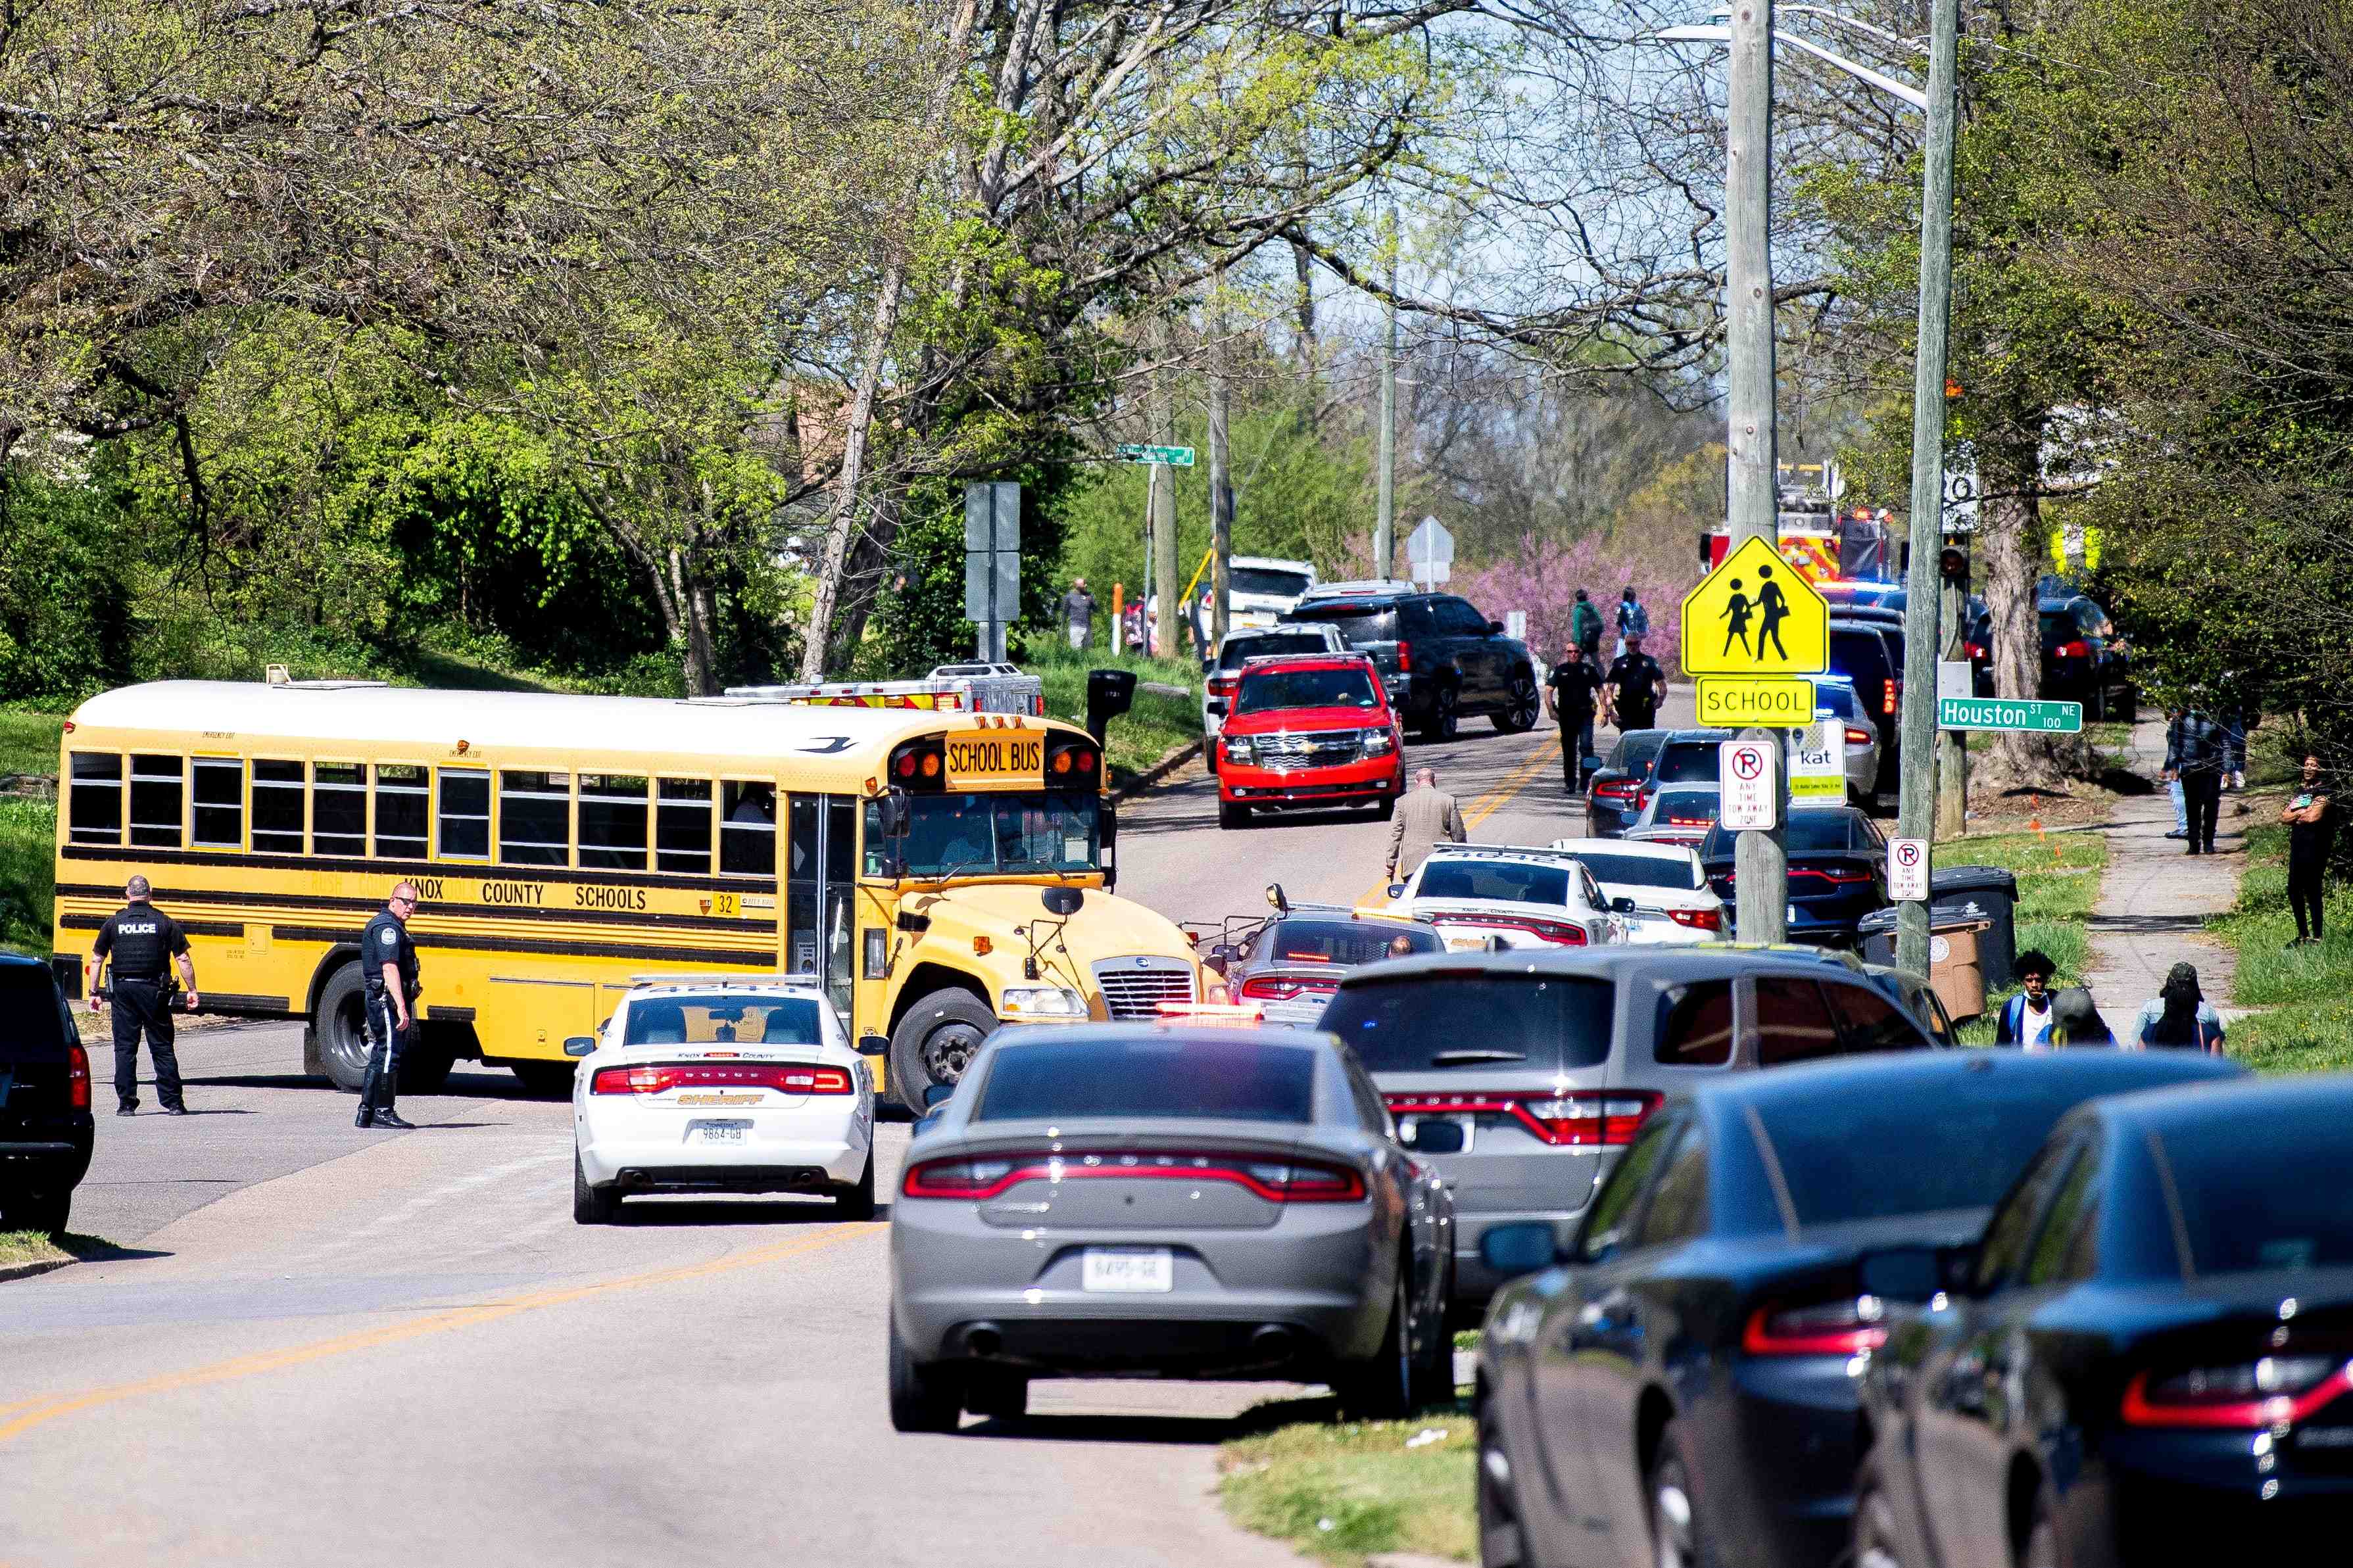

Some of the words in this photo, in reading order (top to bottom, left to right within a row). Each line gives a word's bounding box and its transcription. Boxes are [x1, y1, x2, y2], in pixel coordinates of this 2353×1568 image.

[1708, 692, 1807, 711] SCHOOL
[1944, 701, 2026, 726] Houston
[2030, 703, 2043, 715] ST
[2062, 705, 2075, 716] NE
[2043, 717, 2061, 728] 100
[950, 742, 1006, 772] SCHOOL
[1011, 742, 1040, 771] BUS
[1801, 749, 1831, 765] kat
[1739, 793, 1757, 801] TIME
[1728, 804, 1742, 813] TOW
[1747, 804, 1768, 813] AWAY
[1740, 815, 1757, 824] ZONE
[482, 882, 544, 905] COUNTY
[575, 886, 646, 911] SCHOOLS
[719, 895, 733, 914] 32
[118, 923, 157, 934] POLICE
[677, 1094, 764, 1106] SHERIFF
